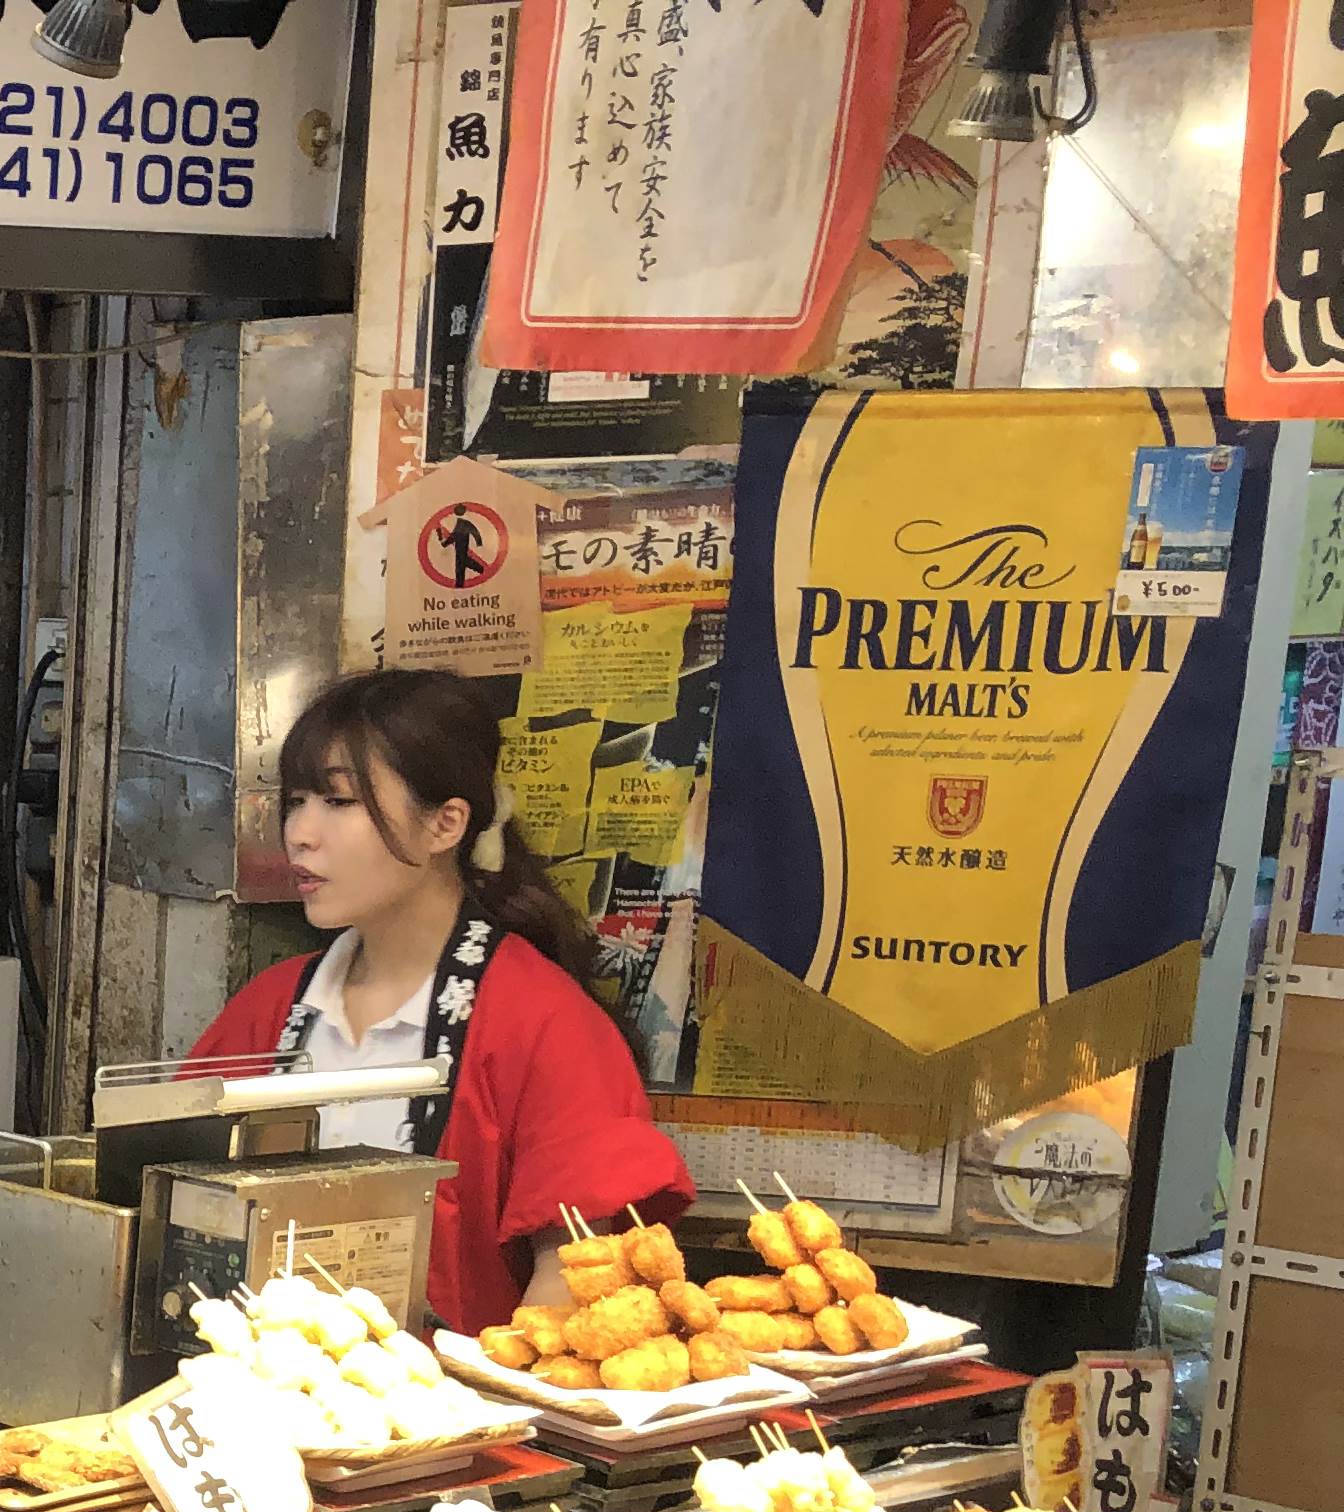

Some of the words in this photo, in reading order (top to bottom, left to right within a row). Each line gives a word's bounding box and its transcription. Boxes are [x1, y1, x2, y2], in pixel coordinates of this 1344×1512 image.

[568, 0, 607, 190] 有ります
[442, 112, 490, 233] 魚力
[543, 521, 737, 574] モの素晴
[895, 520, 1076, 590] The
[408, 616, 450, 633] while
[455, 612, 515, 629] walking
[423, 597, 446, 612] No
[451, 594, 500, 609] eating
[790, 586, 1169, 673] PREMIUM
[905, 676, 1030, 718] MALT'S
[890, 844, 1008, 871] 天然水醸造
[850, 935, 1029, 969] SUNTORY
